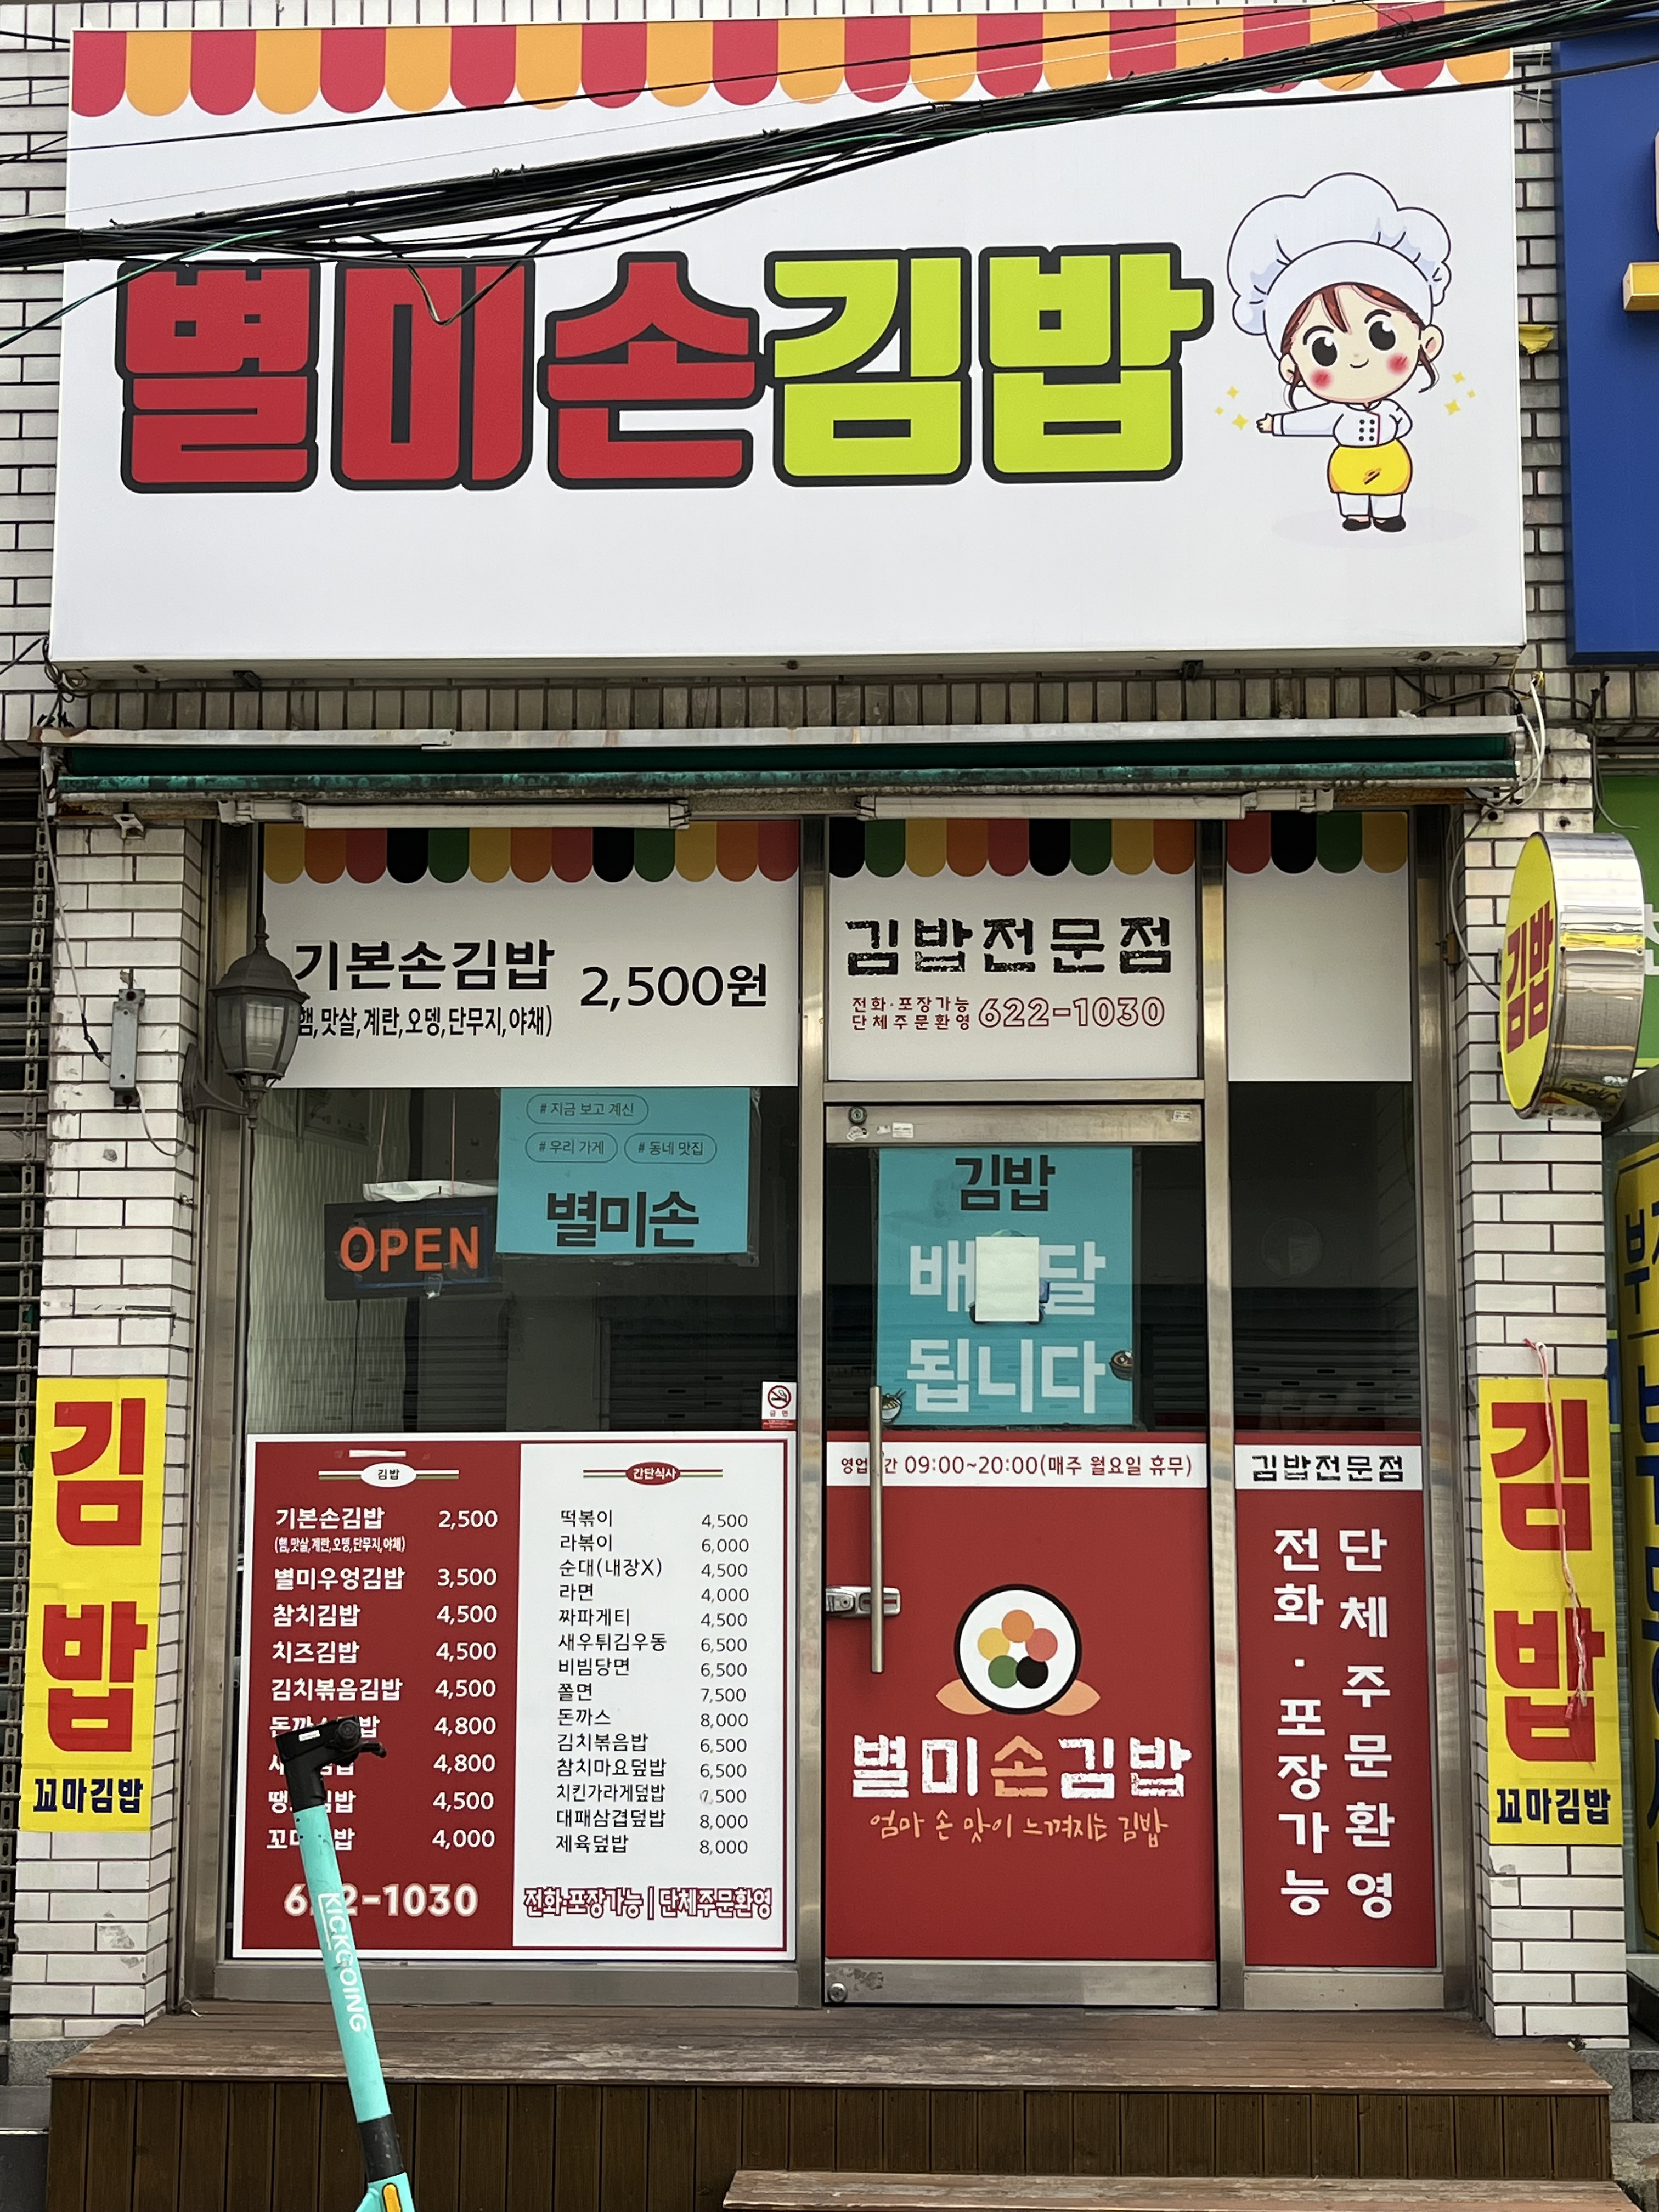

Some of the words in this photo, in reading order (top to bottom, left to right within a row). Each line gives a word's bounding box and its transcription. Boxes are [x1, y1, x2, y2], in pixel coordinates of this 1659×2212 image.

[116, 244, 1214, 493] 별미손김밥
[845, 917, 1171, 975] 김밥전문점
[295, 940, 554, 991] 기본손김밥
[580, 963, 767, 1012] 2,500원
[1506, 900, 1554, 1053] 김밥
[978, 997, 1165, 1028] 622-1030
[550, 1102, 576, 1116] 지금
[579, 1103, 605, 1115] 보고
[608, 1103, 634, 1117] 계신
[549, 1140, 574, 1154] 우리
[579, 1140, 604, 1154] 가게
[648, 1141, 674, 1155] 동네
[678, 1142, 703, 1156] 맛집
[955, 1154, 1056, 1211] 김밥
[547, 1191, 699, 1248] 별미손
[340, 1226, 479, 1272] OPEN
[906, 1338, 1106, 1414] 됩니다
[377, 1469, 400, 1480] 김밥
[633, 1468, 676, 1480] 간단식사
[841, 1457, 898, 1475] 영업간
[1090, 1455, 1142, 1476] 월요일
[1149, 1455, 1192, 1477] 휴무)
[1251, 1454, 1405, 1483] 김밥전문점
[276, 1506, 385, 1530] 기본손김밥
[438, 1510, 498, 1530] 2,500
[561, 1509, 613, 1528] 떡볶이
[701, 1514, 748, 1530] 4,500
[560, 1534, 613, 1552] 라볶이
[701, 1539, 749, 1554] 6,000
[275, 1567, 405, 1590] 별미우엉김밥
[437, 1569, 497, 1589] 3,500
[559, 1559, 663, 1577] 순대(내장X)
[701, 1564, 748, 1579] 4,500
[559, 1583, 594, 1601] 라면
[701, 1588, 749, 1603] 4,000
[273, 1604, 361, 1627] 참치김밥
[437, 1605, 497, 1625] 4,500
[558, 1609, 630, 1627] 짜파게티
[700, 1613, 748, 1628] 4,500
[272, 1641, 360, 1664] 치즈김밥
[436, 1642, 497, 1662] 4,500
[558, 1633, 668, 1651] 새우튀김우동
[700, 1638, 748, 1653] 6,500
[558, 1658, 630, 1677] 비빔당면
[700, 1663, 748, 1678] 6,500
[271, 1678, 403, 1701] 김치볶음김밥
[435, 1679, 496, 1700] 4,500
[557, 1683, 592, 1701] 쫄면
[700, 1688, 747, 1703] 7,500
[269, 1716, 381, 1739] 돈까밥
[435, 1717, 496, 1737] 4,800
[557, 1708, 611, 1727] 돈까스
[700, 1713, 748, 1729] 8,000
[1338, 1528, 1395, 1919] 단체주문환영
[557, 1733, 648, 1752] 김치볶음밥
[700, 1739, 747, 1754] 6,500
[433, 1754, 496, 1774] 4,800
[556, 1758, 667, 1778] 참치마요덮밥
[699, 1764, 747, 1779] 6,500
[851, 1734, 1193, 1800] 별미손김밥
[33, 1778, 144, 1814] 꼬마김밥
[268, 1790, 357, 1814] 땡밥
[432, 1791, 494, 1812] 4,500
[556, 1784, 665, 1803] 치킨가라게덮밥
[1497, 1788, 1611, 1825] 꼬마김밥
[556, 1809, 667, 1827] 대패삼겹덮밥
[699, 1814, 748, 1830] 8,000
[870, 1809, 926, 1839] 엄마
[935, 1809, 953, 1841] 손
[963, 1807, 1012, 1843] 맛이
[1023, 1813, 1108, 1842] 느껴지는
[1118, 1807, 1169, 1848] 김밥
[432, 1830, 495, 1850] 4,000
[556, 1834, 629, 1853] 제육덮밥
[699, 1839, 748, 1855] 8,000
[284, 1883, 479, 1917] 62-1030
[659, 1887, 773, 1920] 단체주문환영
